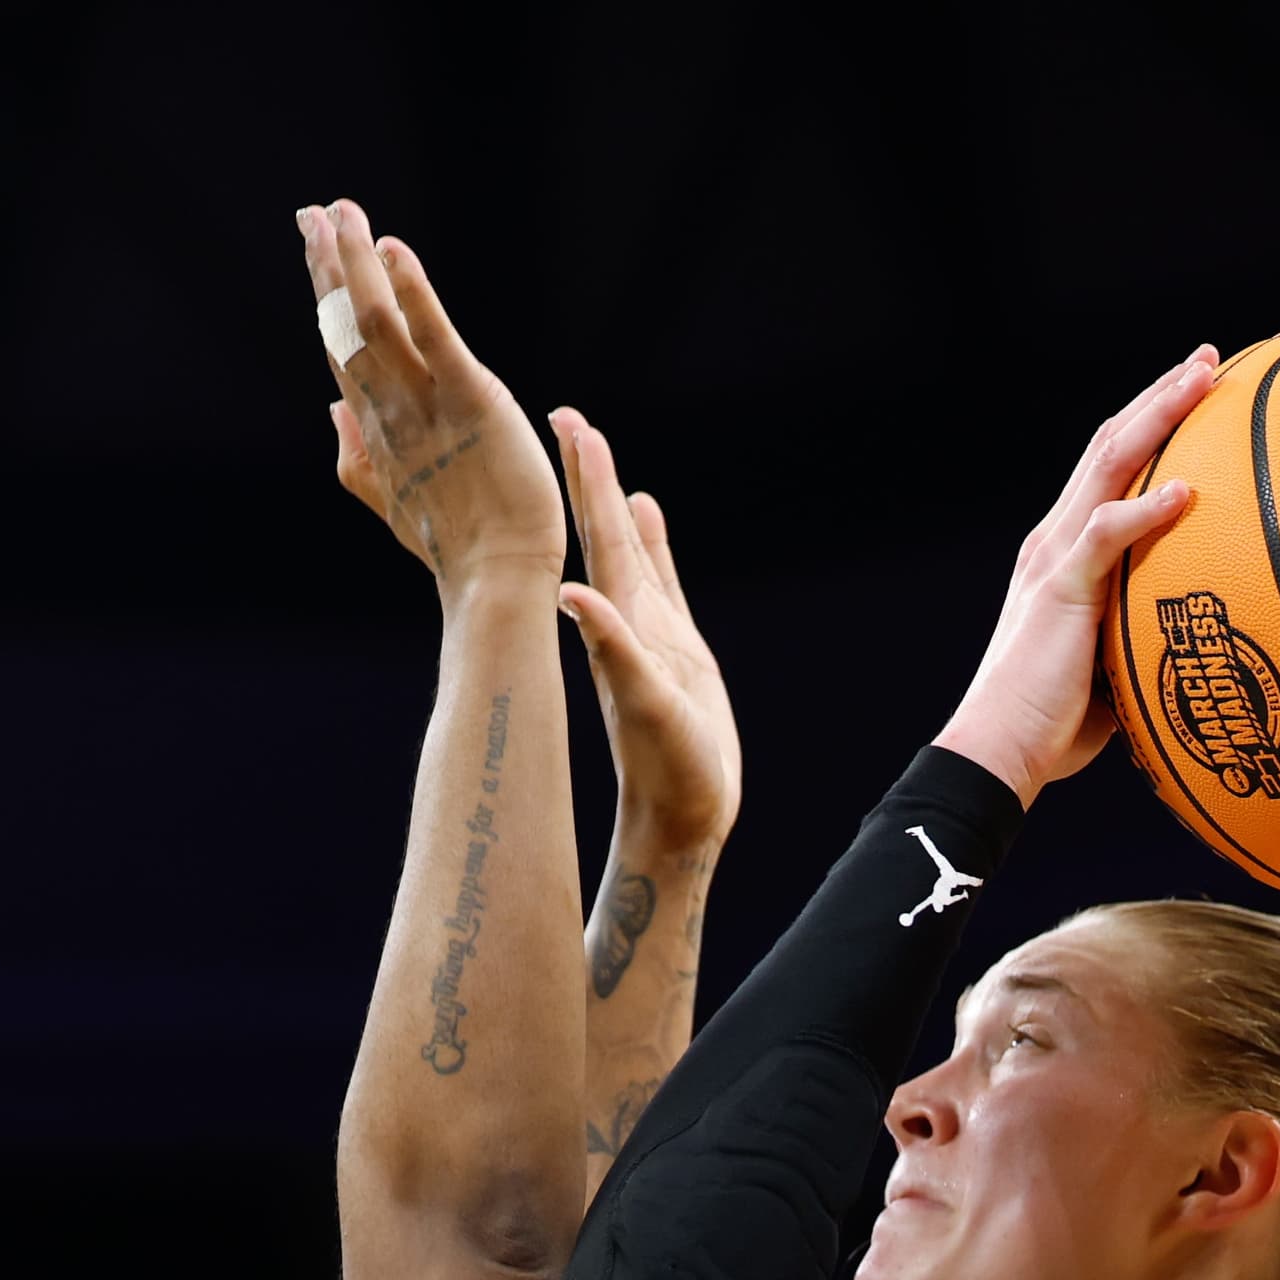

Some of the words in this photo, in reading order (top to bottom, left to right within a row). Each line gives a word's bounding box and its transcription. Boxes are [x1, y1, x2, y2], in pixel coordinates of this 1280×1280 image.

[1187, 595, 1260, 746] MADNESS
[1255, 665, 1266, 676] 8
[1169, 708, 1193, 745] SWEET
[1175, 657, 1241, 765] MARCH
[465, 802, 499, 842] for
[482, 778, 500, 793] a
